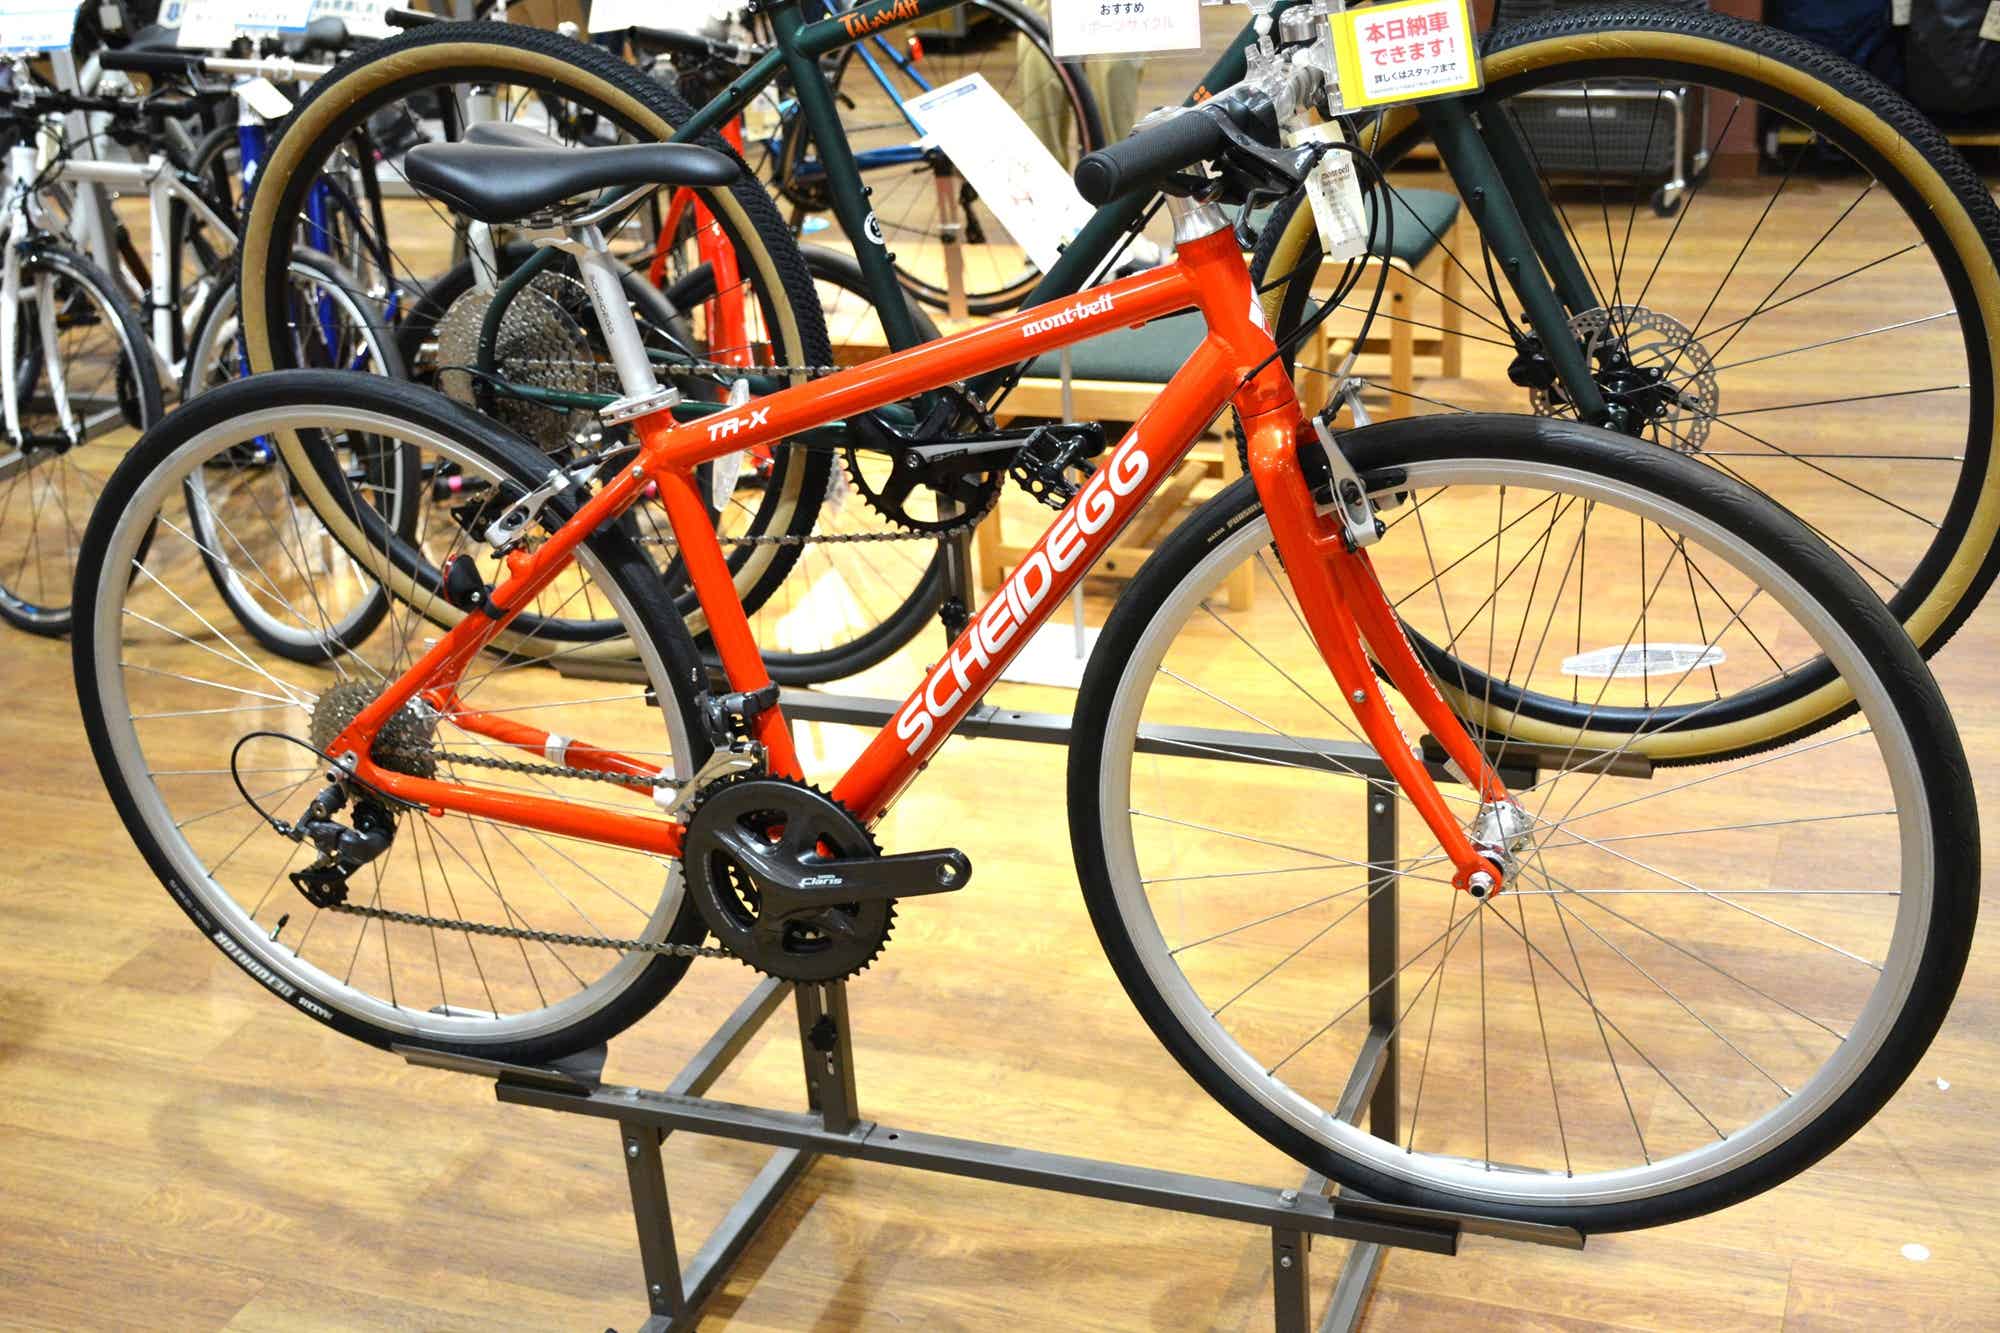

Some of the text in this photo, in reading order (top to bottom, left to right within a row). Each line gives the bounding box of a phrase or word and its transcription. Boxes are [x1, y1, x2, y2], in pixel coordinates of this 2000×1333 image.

[1100, 3, 1145, 16] おすすめ
[1365, 11, 1450, 43] 本日納車
[896, 430, 1150, 756] SCHEIDEGG
